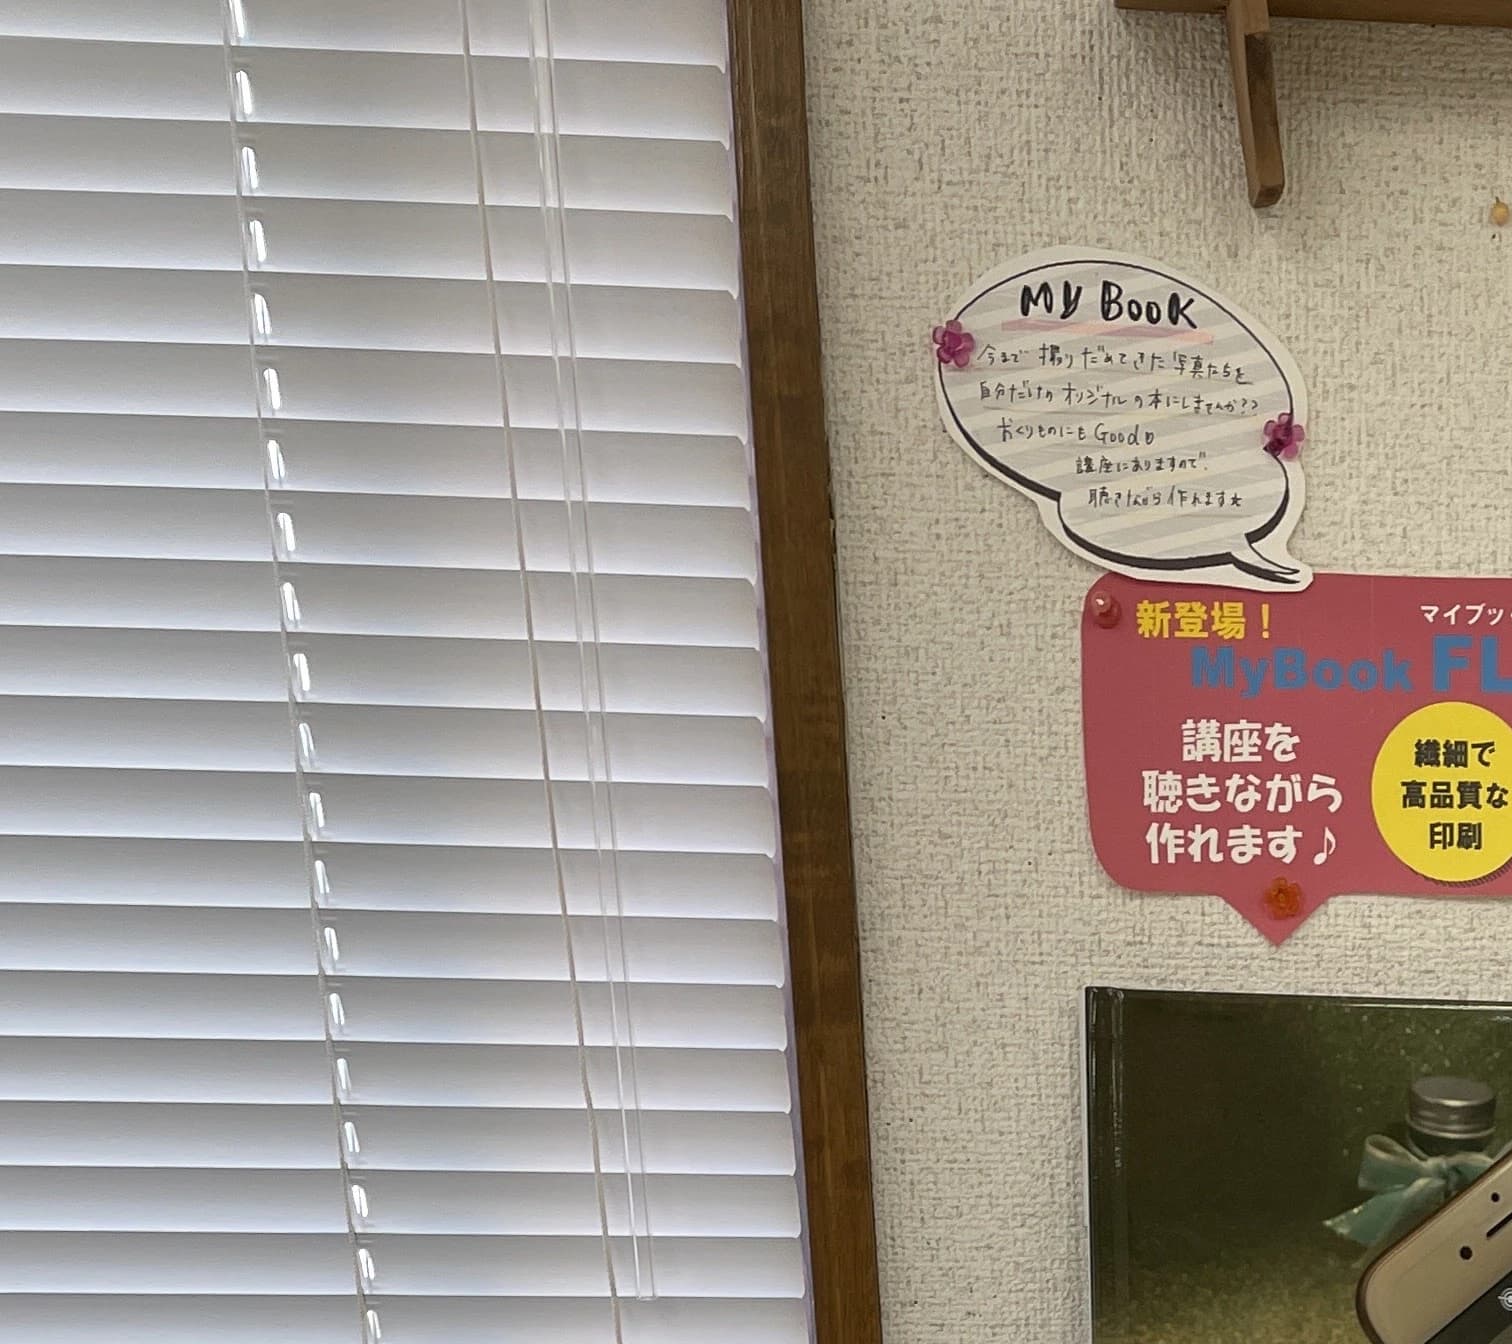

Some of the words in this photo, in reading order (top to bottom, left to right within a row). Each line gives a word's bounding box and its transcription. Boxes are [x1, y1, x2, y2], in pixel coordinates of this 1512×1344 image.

[1190, 645, 1412, 698] MyBook
[1181, 719, 1301, 763] 講座を
[1414, 740, 1496, 769] 繊細で
[1142, 771, 1343, 814] 聴きながら
[1400, 780, 1510, 809] 高品質な
[1428, 822, 1484, 850] 印刷
